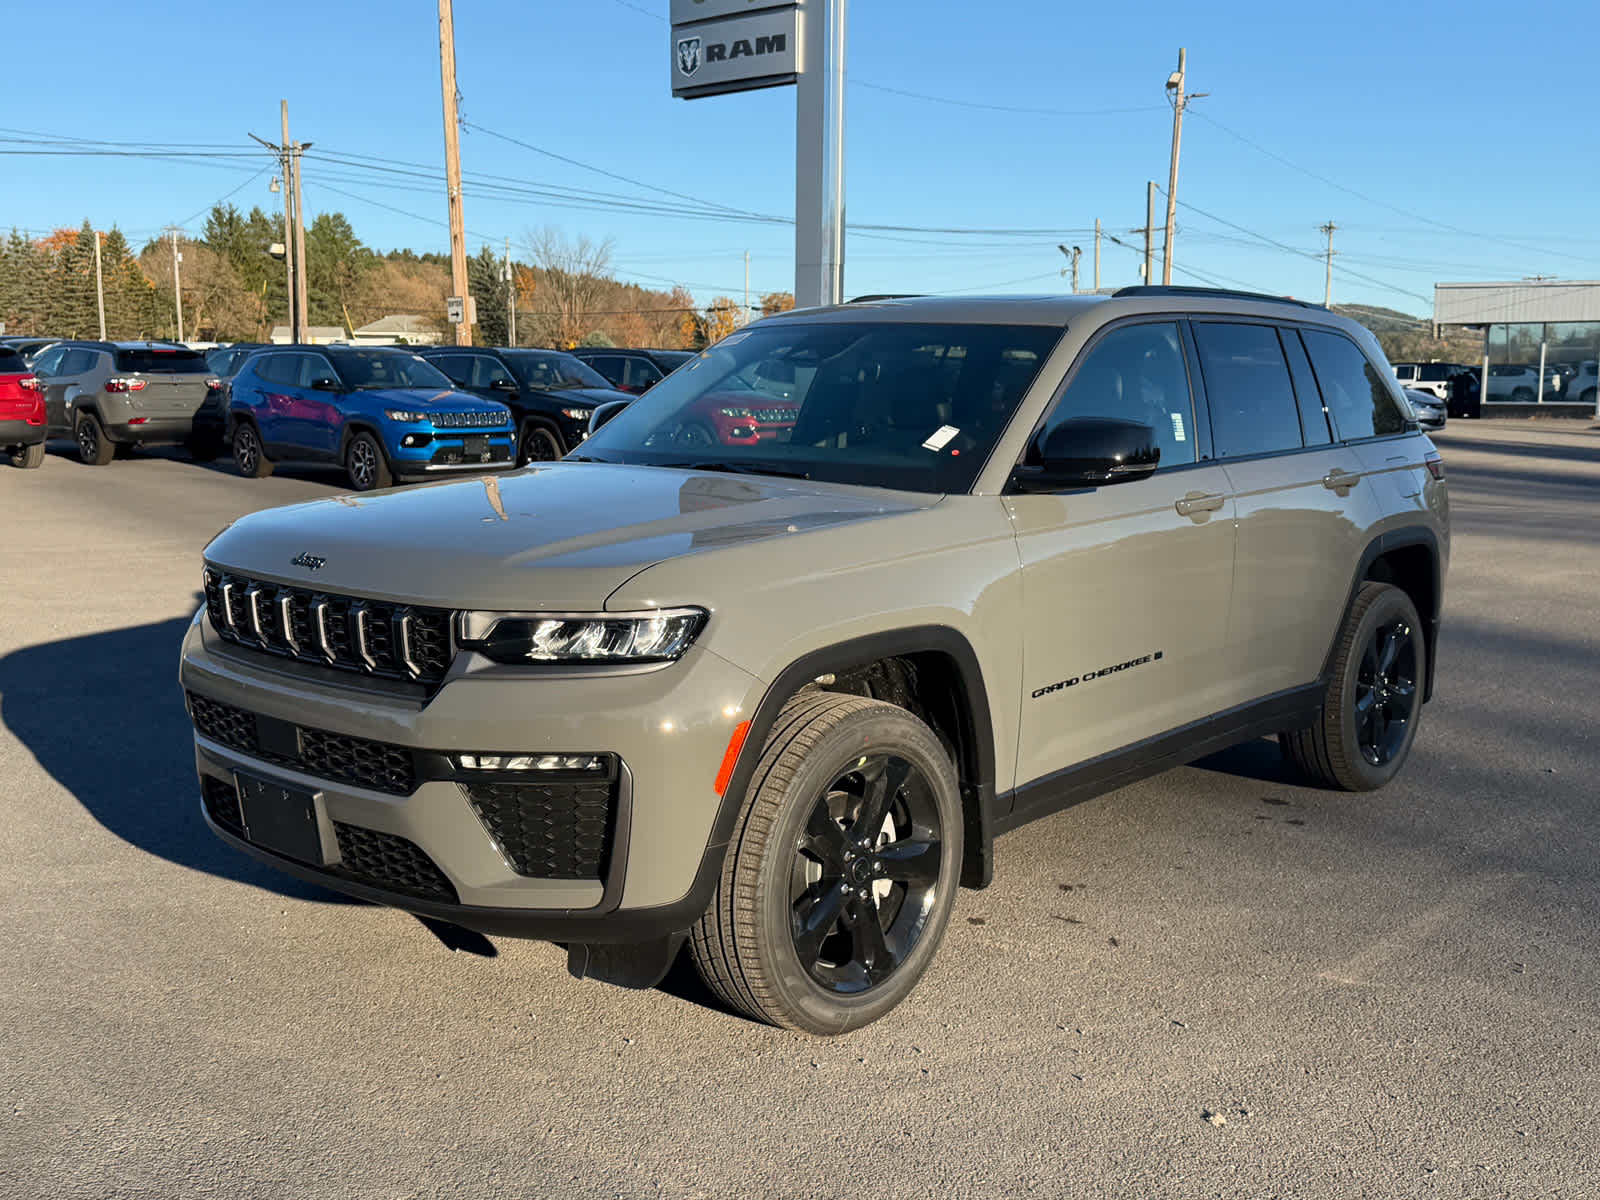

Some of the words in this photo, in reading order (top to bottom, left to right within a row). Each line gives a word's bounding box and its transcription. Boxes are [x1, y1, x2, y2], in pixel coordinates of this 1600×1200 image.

[706, 34, 786, 62] RAM
[1032, 677, 1079, 698] GRAND
[1082, 655, 1151, 681] CHEROKEE
